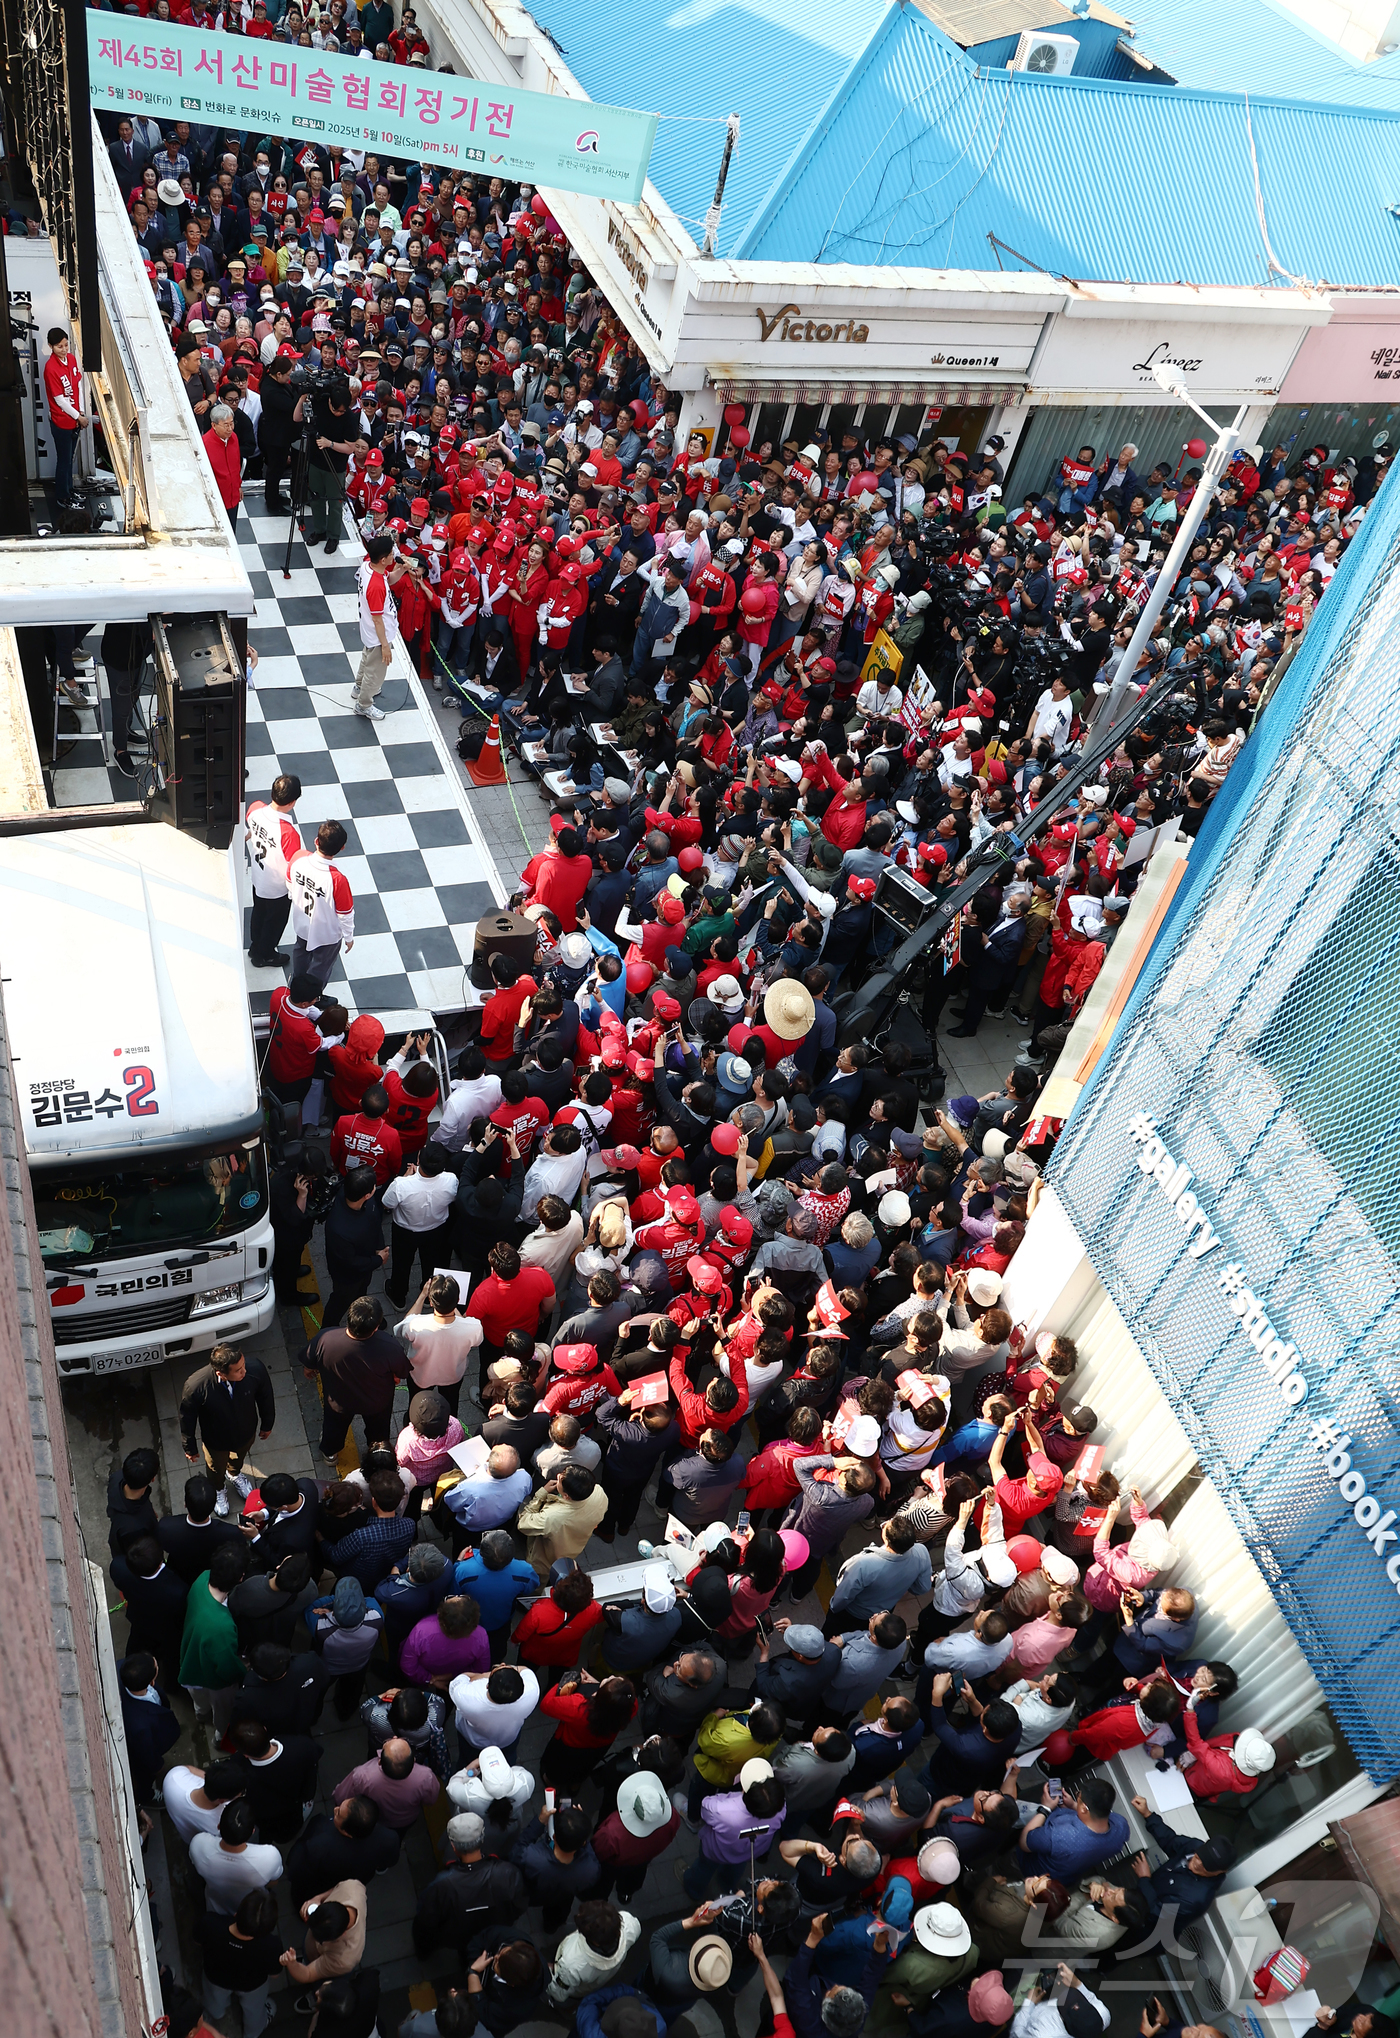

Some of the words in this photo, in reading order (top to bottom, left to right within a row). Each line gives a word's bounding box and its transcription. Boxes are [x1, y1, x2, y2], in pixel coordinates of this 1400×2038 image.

[98, 37, 184, 77] 제45회
[194, 47, 515, 139] 서산미술협회정기전
[107, 85, 125, 100] 5월
[127, 89, 173, 107] 30일(Fri)
[182, 98, 200, 110] 장소
[205, 100, 237, 117] 번화로
[240, 106, 282, 124] 문화잇슈
[293, 116, 325, 130] 오픈일시
[327, 122, 361, 139] 2025년
[363, 126, 379, 142] 5월
[466, 147, 485, 162] 후원
[566, 159, 605, 174] 한국미술협회
[605, 167, 631, 181] 서산지부
[607, 216, 649, 295] Victoria
[756, 303, 870, 343] Victoria
[946, 355, 999, 367] Queen1세
[1373, 369, 1393, 380] Nail
[370, 452, 376, 460] 2
[791, 466, 809, 484] 김문수
[501, 535, 508, 543] 2
[459, 557, 465, 565] 2
[703, 568, 723, 585] 김문수
[825, 599, 842, 616] 김문수
[251, 819, 277, 849] 김문수
[254, 840, 268, 871] 2
[295, 870, 326, 899] 김문수
[303, 891, 315, 918] 2
[123, 1045, 151, 1055] 국민의힘
[29, 1078, 76, 1096] 정정당당
[122, 1065, 160, 1118] 2
[30, 1087, 125, 1128] 김문수
[344, 1133, 384, 1157] 김문수
[662, 1241, 701, 1259] 김문수
[96, 1268, 194, 1298] 국민의힘
[1127, 1109, 1225, 1261] #gallery
[1217, 1261, 1310, 1406] #studio
[1307, 1416, 1399, 1558] #book
[568, 1384, 607, 1409] 김문수
